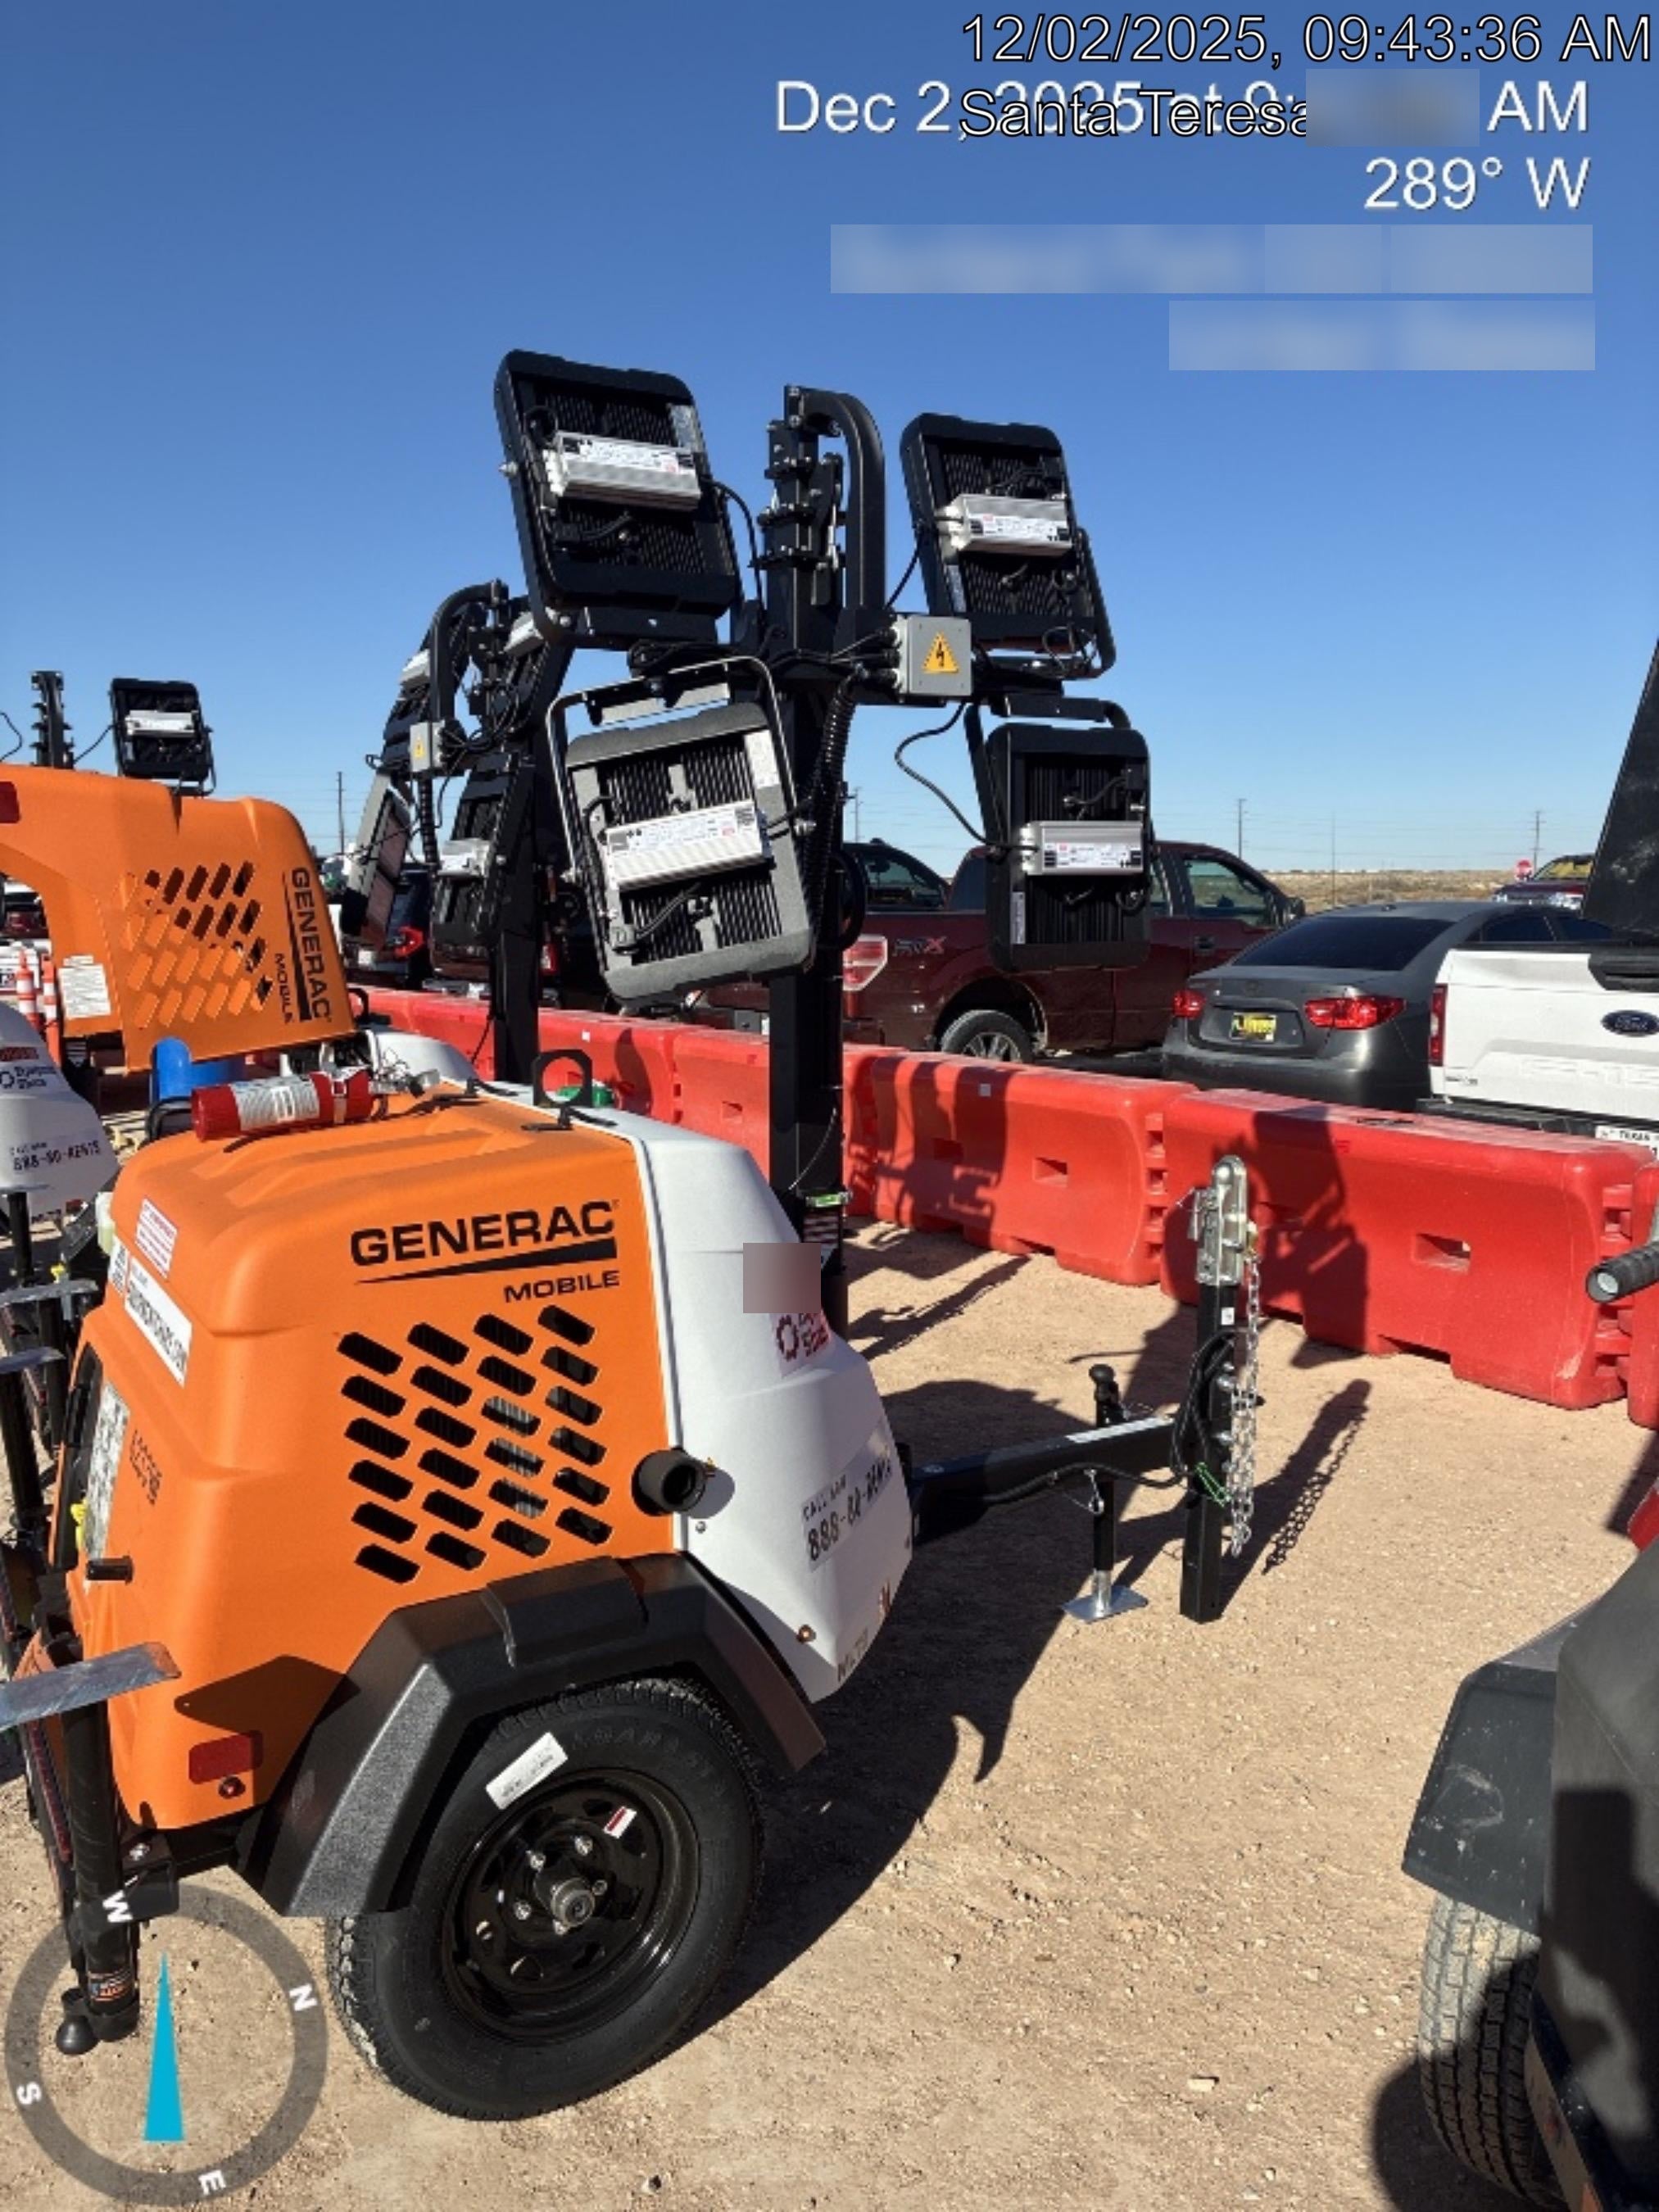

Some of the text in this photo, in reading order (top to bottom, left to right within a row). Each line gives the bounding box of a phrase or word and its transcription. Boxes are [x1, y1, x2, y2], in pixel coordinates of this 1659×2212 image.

[291, 867, 332, 1021] GENERAC
[351, 1200, 616, 1267] GENERAC
[503, 1270, 621, 1303] MOBILE
